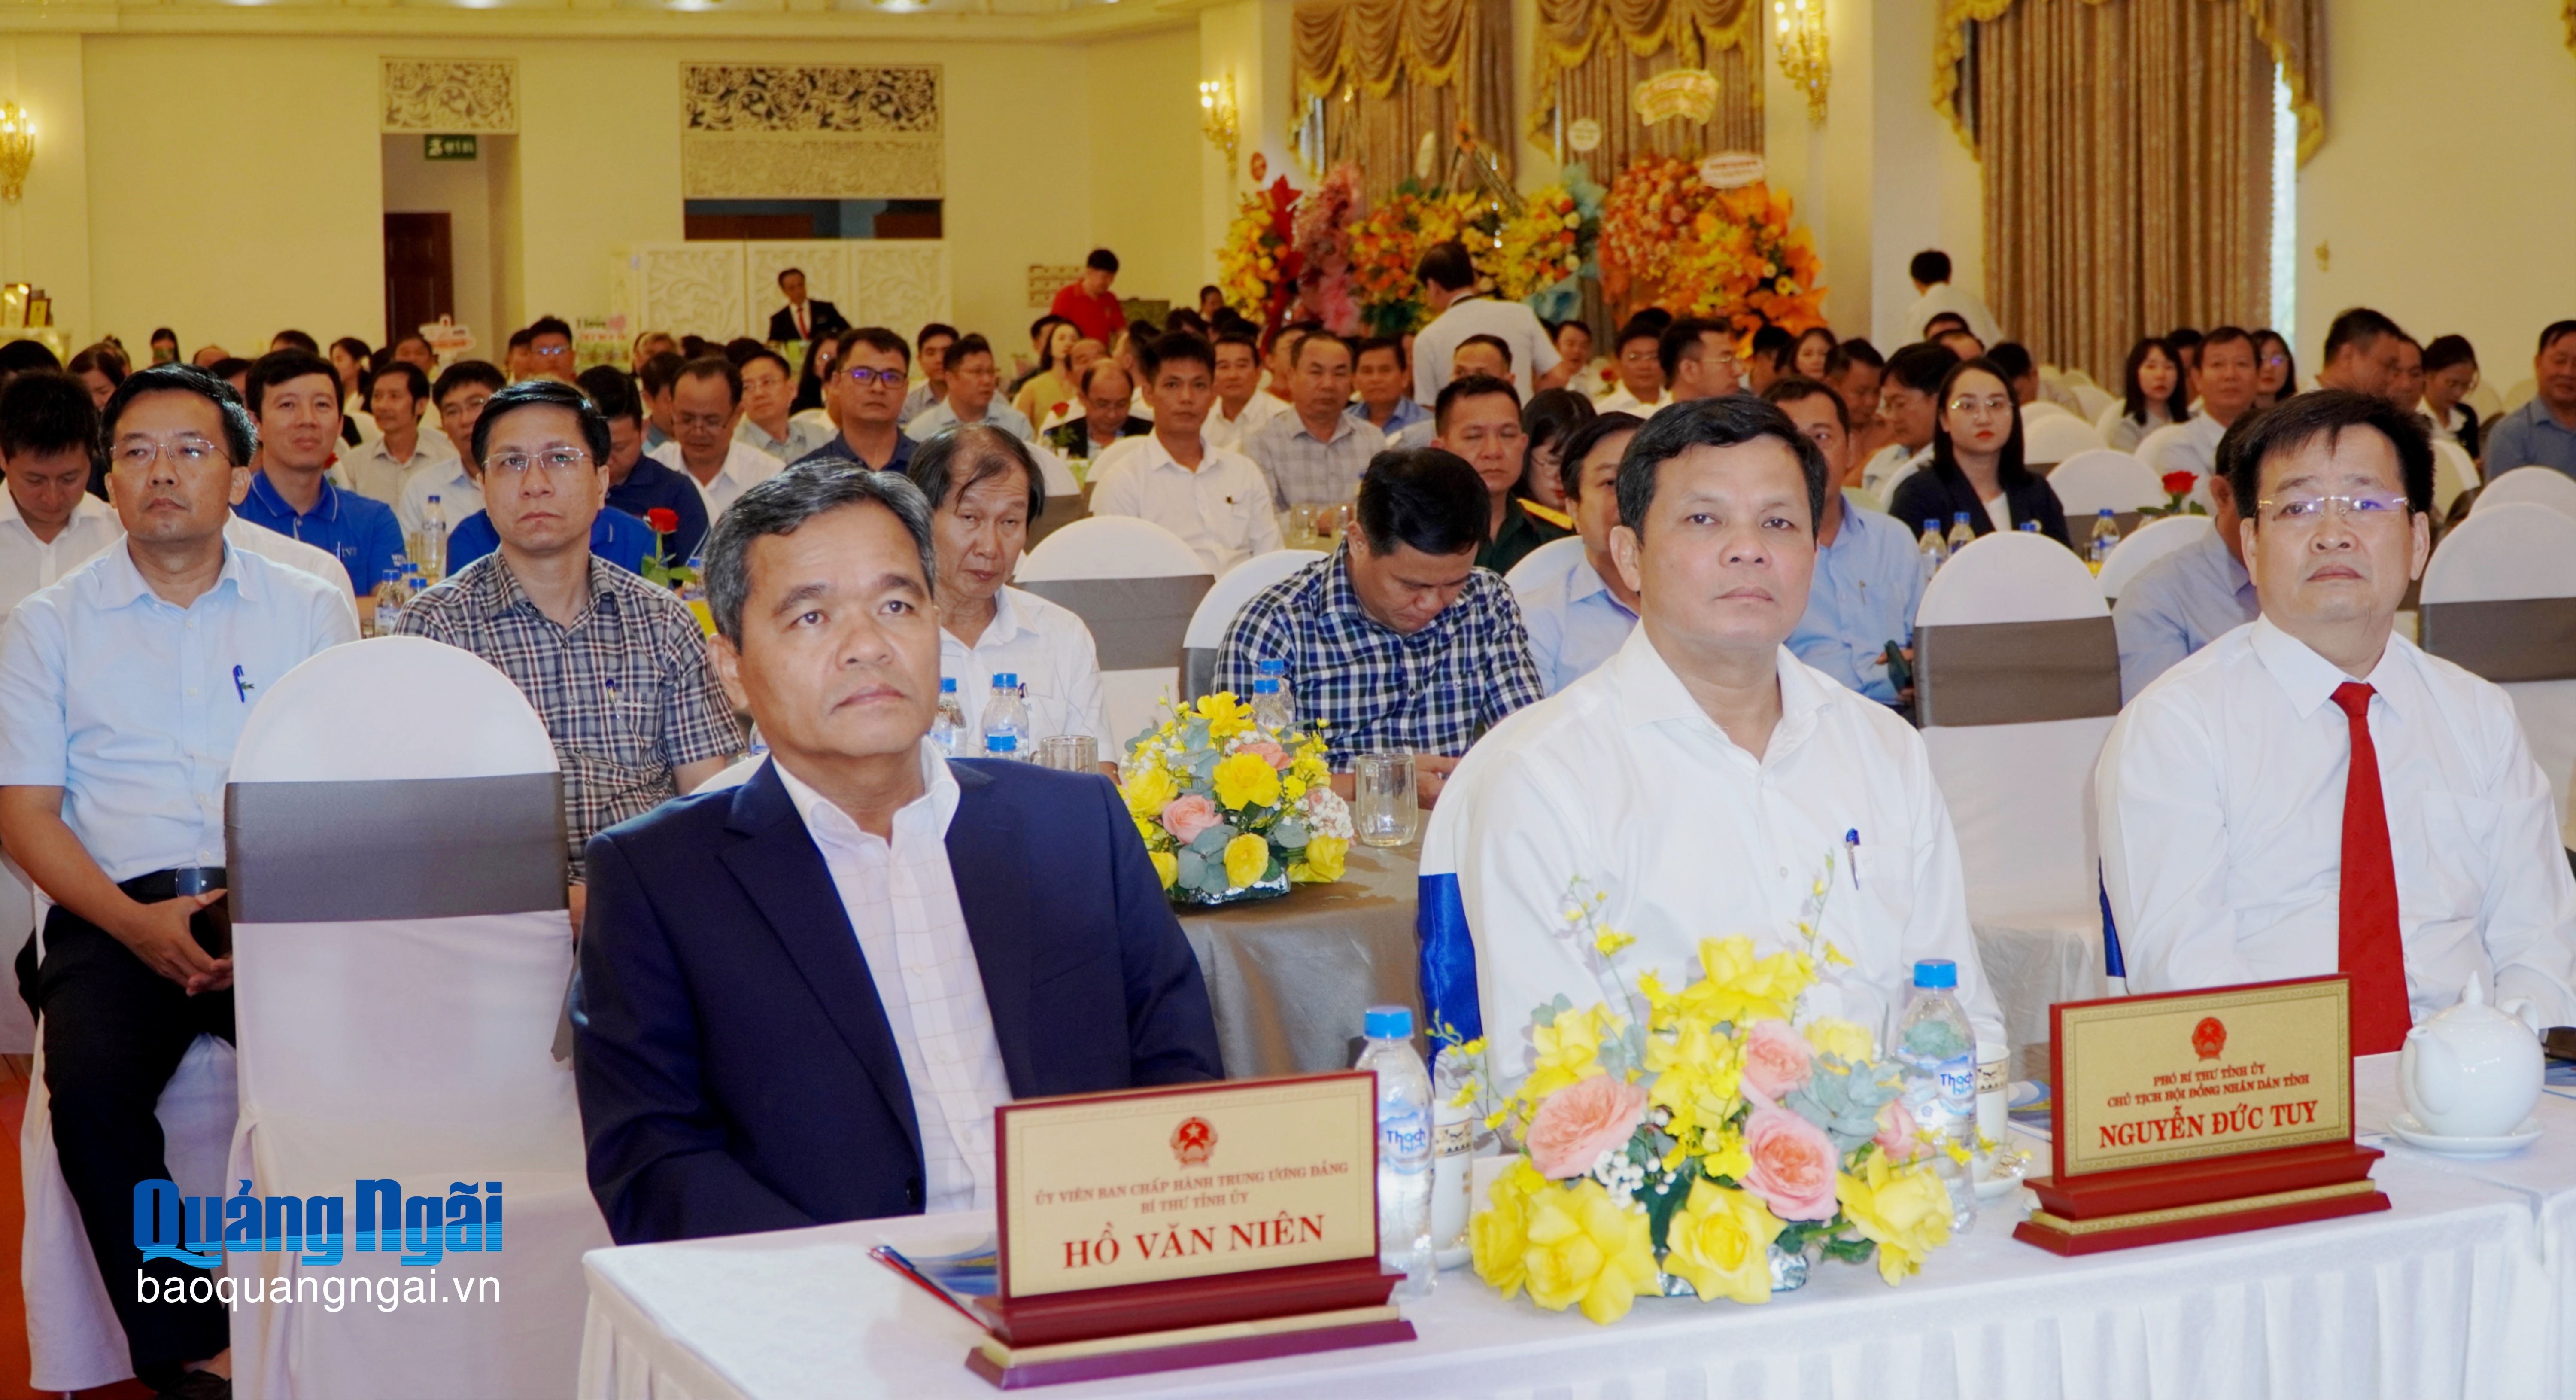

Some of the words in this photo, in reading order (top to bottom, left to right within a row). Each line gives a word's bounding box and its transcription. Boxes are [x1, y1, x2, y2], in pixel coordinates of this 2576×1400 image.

[2107, 1092, 2131, 1107] CHỦ
[2135, 1092, 2162, 1105] TỊCH
[2165, 1087, 2185, 1102] HỘI
[2189, 1083, 2220, 1098] ĐỒNG
[2223, 1080, 2254, 1094] NHÂN
[2257, 1077, 2280, 1090] DÂN
[2283, 1072, 2309, 1087] TỈNH
[2154, 1072, 2177, 1087] PHÓ
[2180, 1071, 2191, 1083] BÍ
[2195, 1068, 2218, 1081] THƯ
[2221, 1065, 2247, 1079] TỈNH
[2251, 1061, 2265, 1074] ỦY
[2099, 1105, 2205, 1148] NGUYỄN
[2211, 1103, 2263, 1134] ĐỨC
[2270, 1100, 2318, 1127] TUY
[1035, 1189, 1055, 1205] ỦY
[1059, 1187, 1094, 1203] VIÊN
[1098, 1186, 1127, 1199] BAN
[1130, 1177, 1170, 1196] CHẤP
[1173, 1176, 1214, 1191] HÀNH
[1218, 1172, 1264, 1187] TRUNG
[1269, 1167, 1306, 1182] ƯƠNG
[1310, 1160, 1349, 1178] ĐẢNG
[1140, 1199, 1155, 1214] BÍ
[1159, 1196, 1190, 1212] THƯ
[1192, 1193, 1225, 1209] TỈNH
[1230, 1189, 1249, 1204] ỦY
[1063, 1222, 1120, 1269] HỒ
[1134, 1223, 1215, 1260] VĂN
[1229, 1211, 1325, 1251] NIÊN
